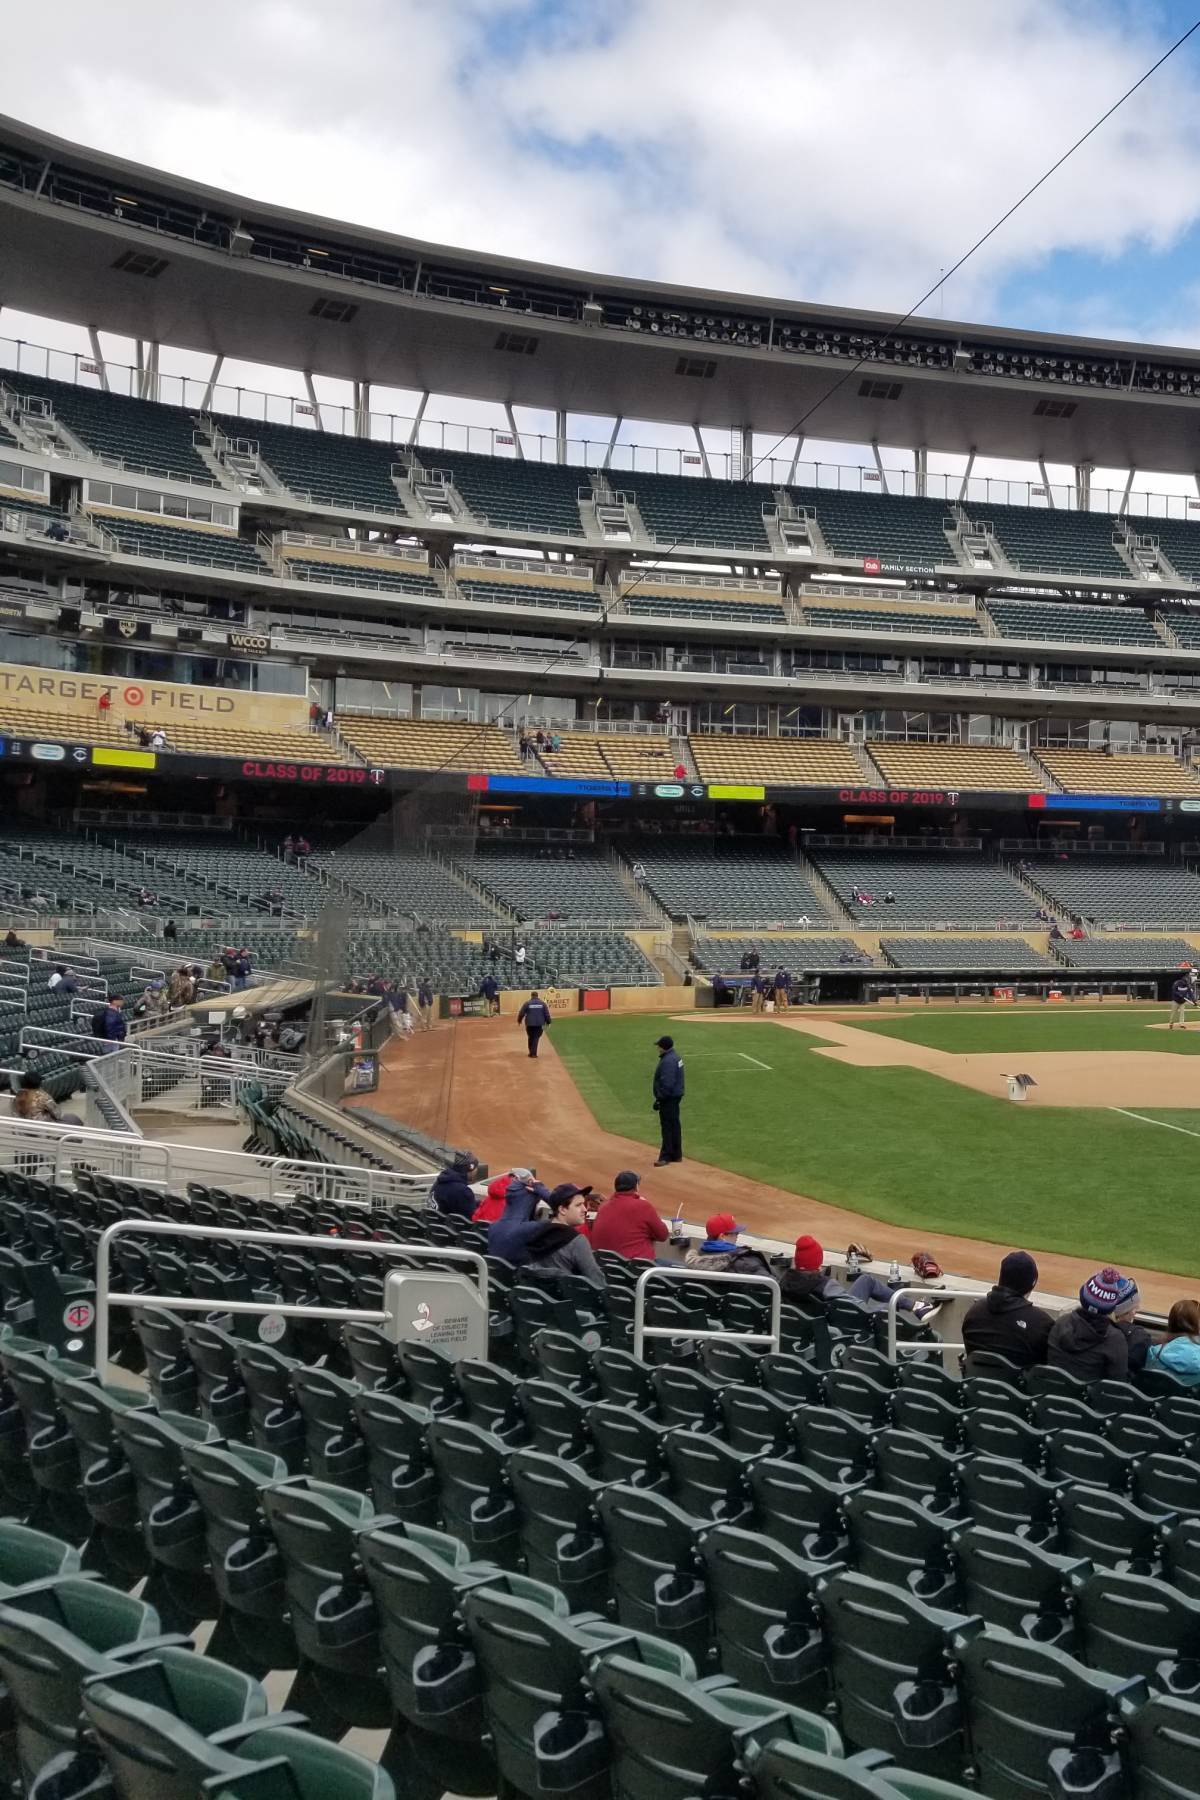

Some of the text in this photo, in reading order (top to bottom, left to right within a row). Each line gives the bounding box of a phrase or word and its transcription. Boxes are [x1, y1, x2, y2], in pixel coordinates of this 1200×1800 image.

[881, 564, 934, 574] FAMILY SECTION
[231, 634, 267, 649] WCCO
[1, 672, 235, 713] TARGET FIELD
[242, 761, 297, 779] CLASS
[301, 766, 323, 781] OF
[327, 768, 366, 783] 2019
[839, 790, 885, 803] CLASS
[888, 791, 909, 804] OF
[911, 792, 944, 804] 2019
[1088, 1279, 1116, 1300] TWINS
